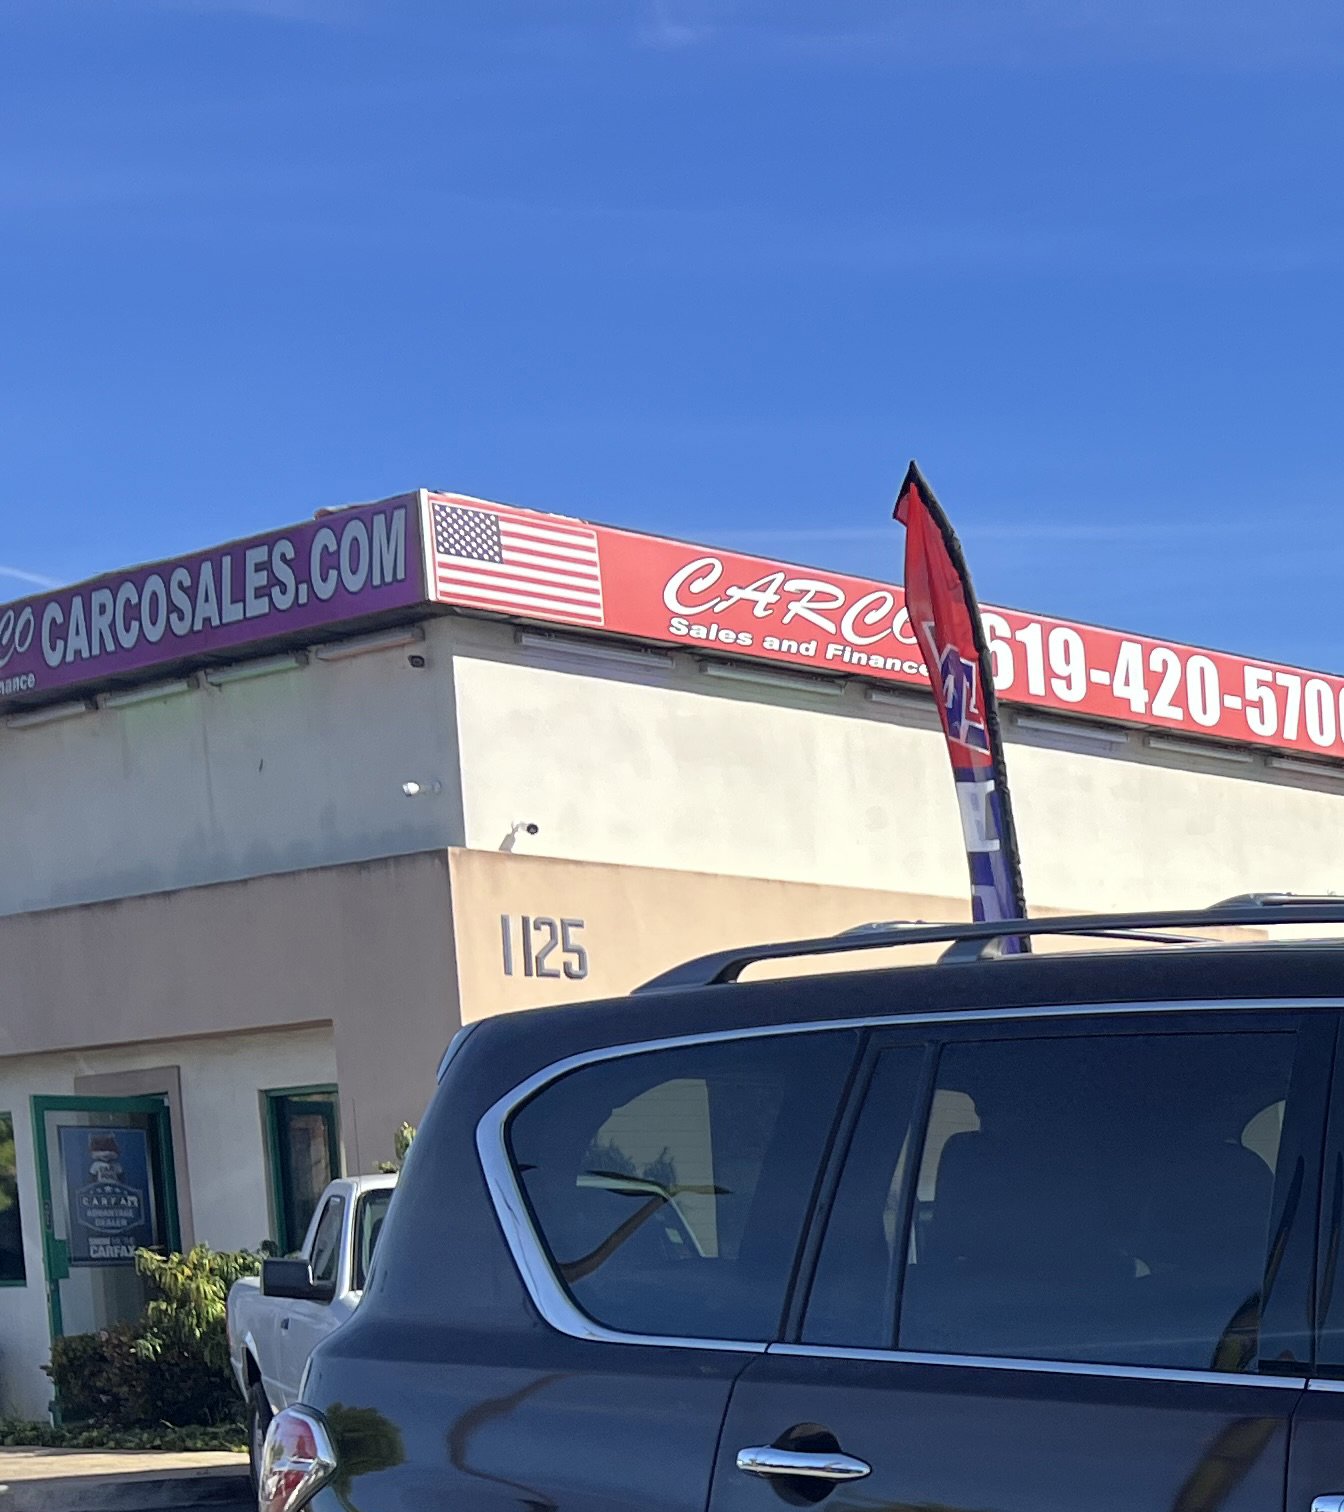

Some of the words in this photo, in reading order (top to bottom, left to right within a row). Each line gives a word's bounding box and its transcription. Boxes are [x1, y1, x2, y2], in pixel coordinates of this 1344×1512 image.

[42, 509, 408, 668] CARCOSALES.COM
[669, 617, 753, 646] Sales
[762, 634, 818, 657] and
[500, 914, 588, 980] 1125
